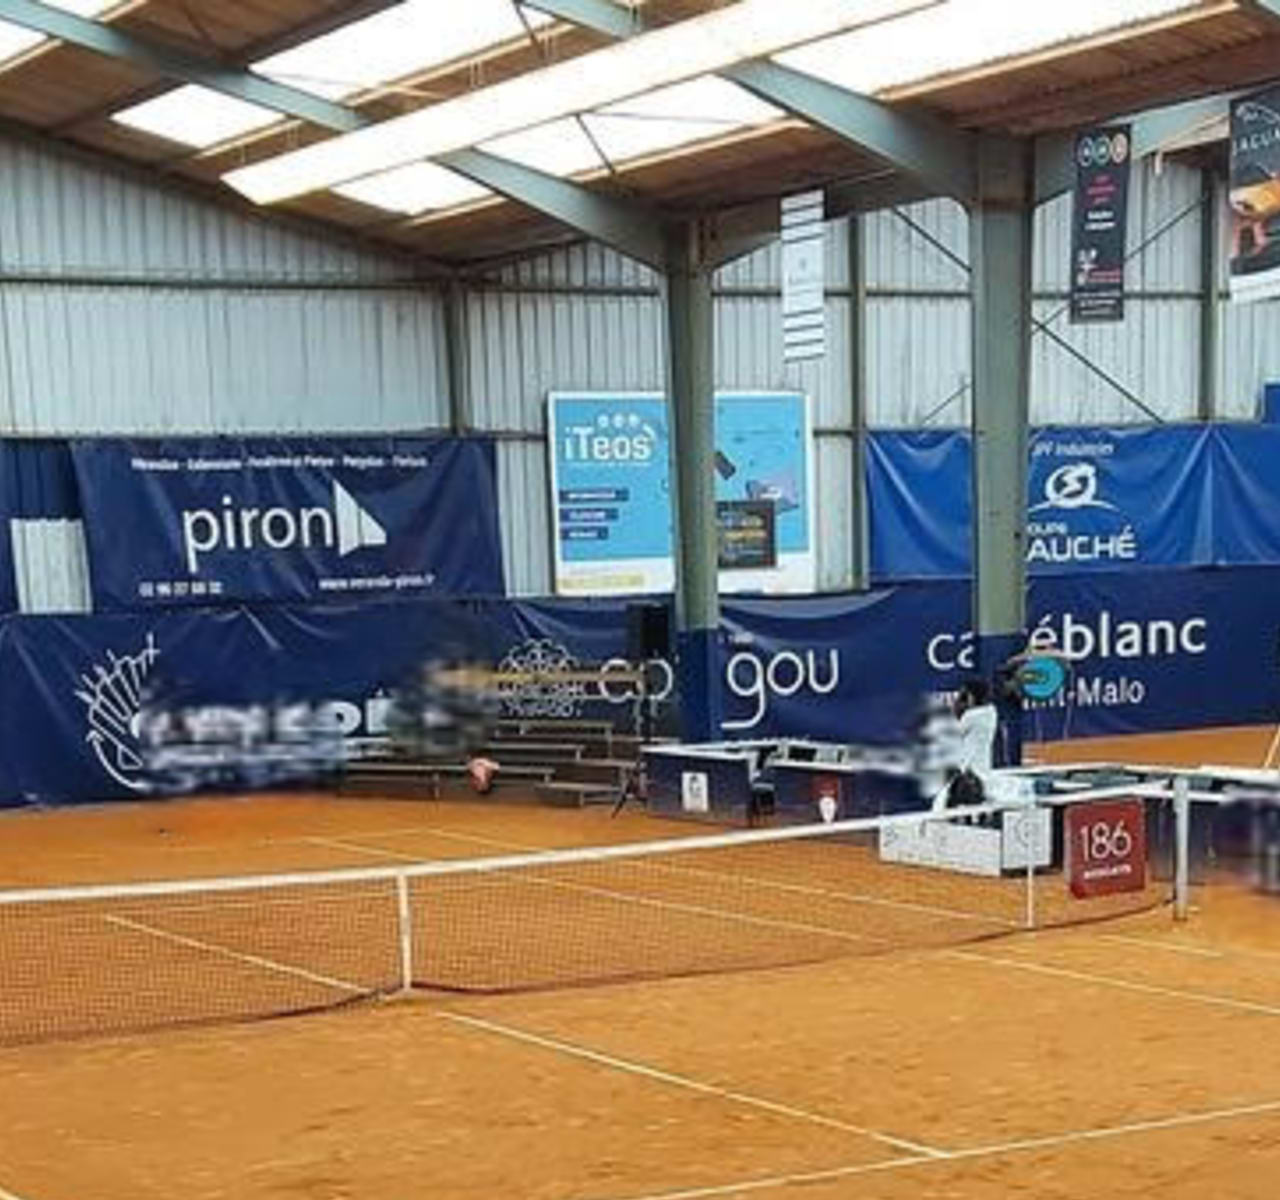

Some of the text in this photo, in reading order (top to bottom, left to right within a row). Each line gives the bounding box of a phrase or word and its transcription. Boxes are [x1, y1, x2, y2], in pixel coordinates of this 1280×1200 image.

[183, 496, 334, 573] piron
[1025, 524, 1137, 562] AUCHÉ
[1080, 820, 1132, 862] 186
